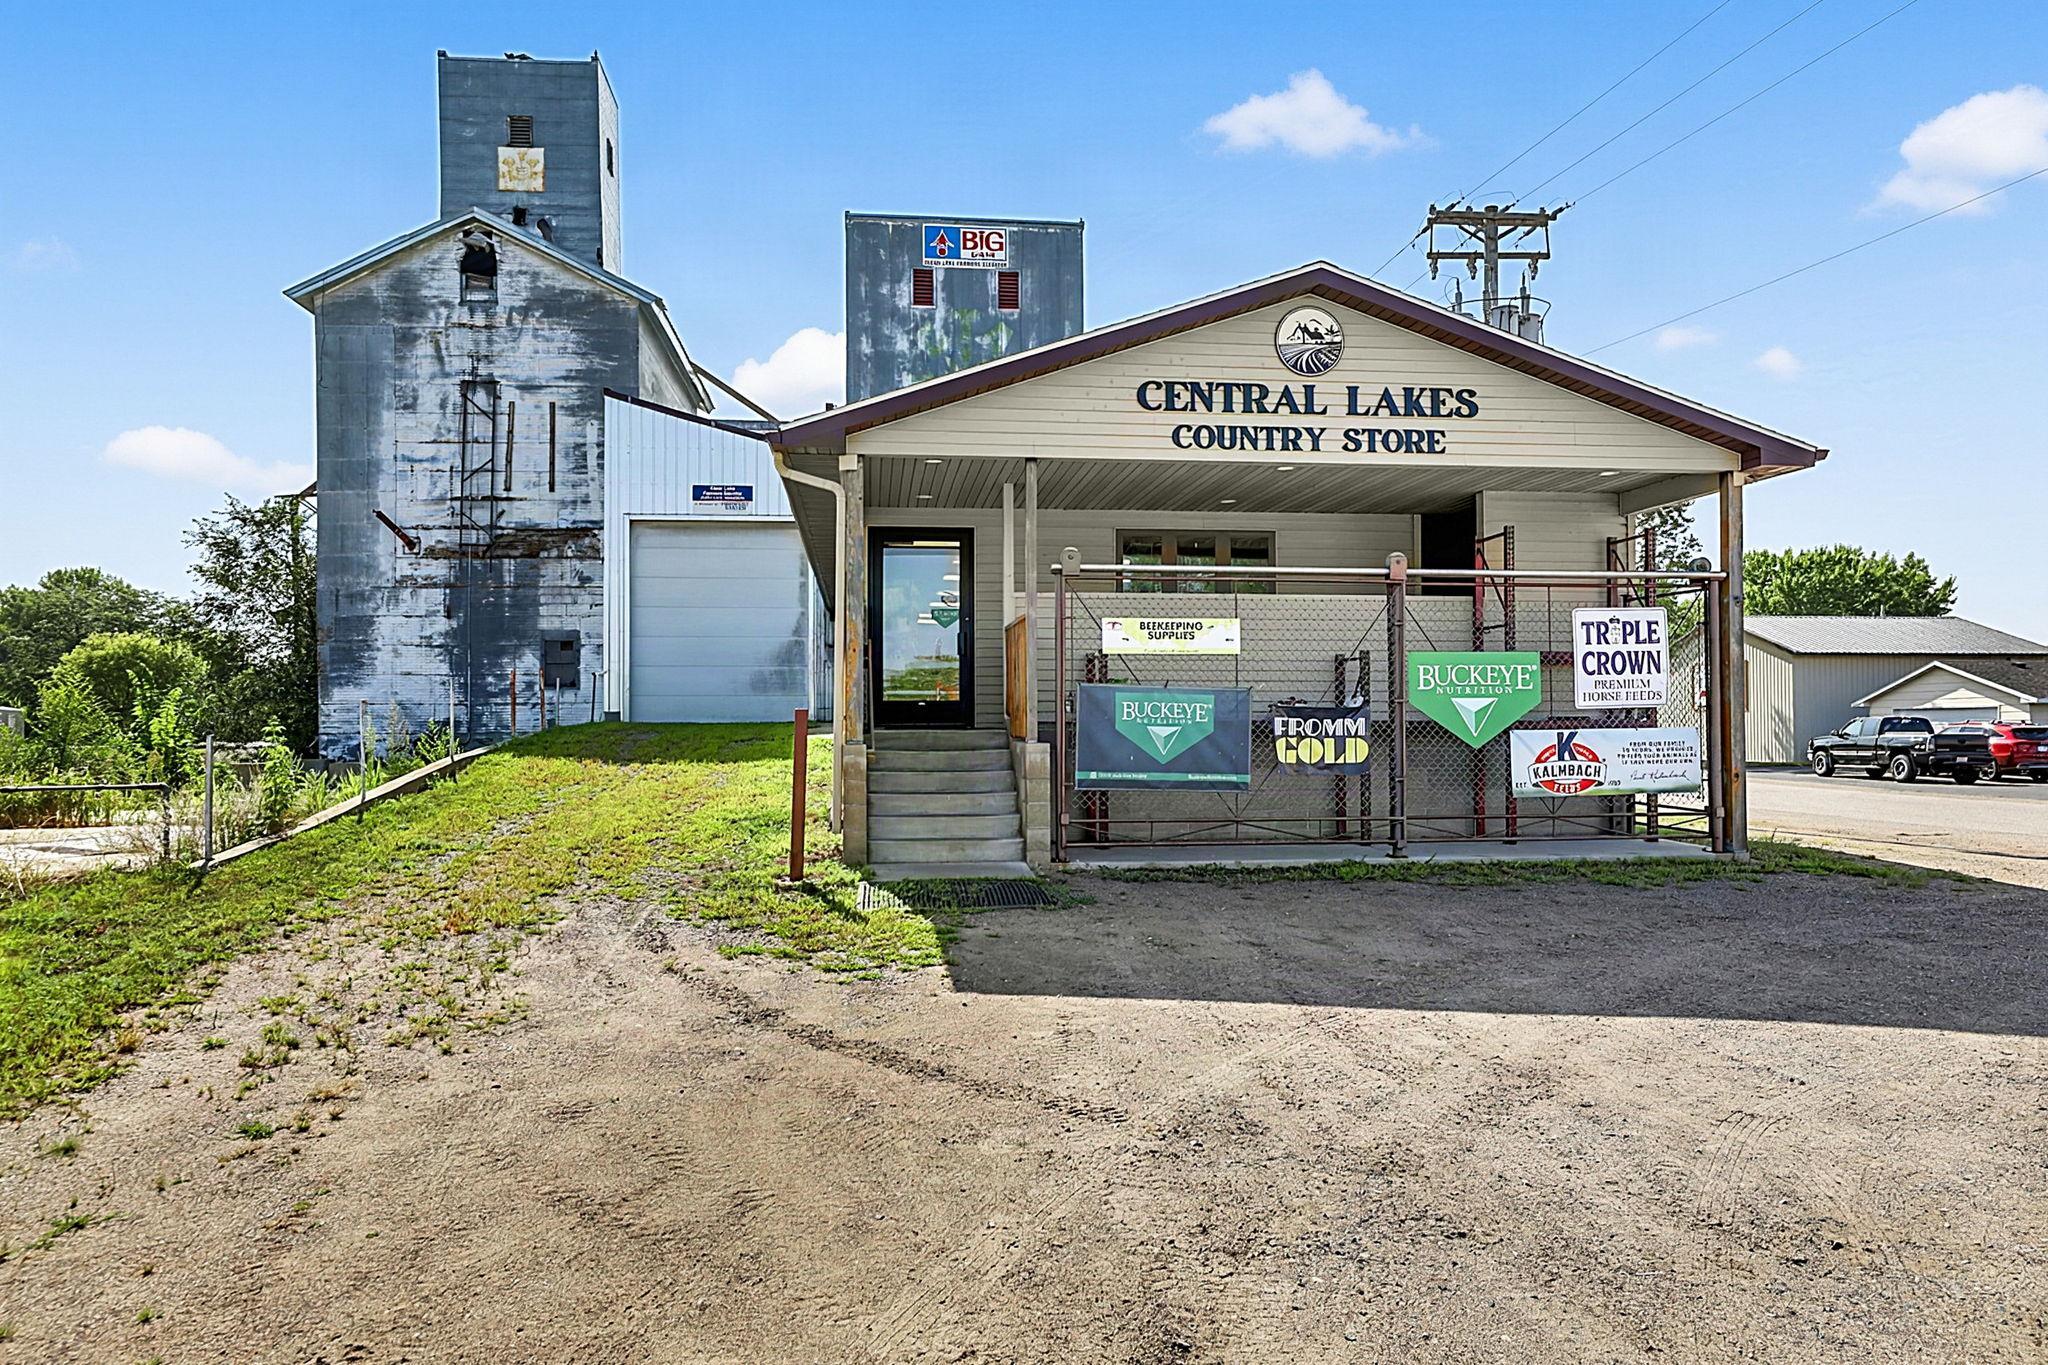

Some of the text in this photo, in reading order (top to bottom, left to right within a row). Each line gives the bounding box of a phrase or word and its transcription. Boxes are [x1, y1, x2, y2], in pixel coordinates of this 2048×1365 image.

[1136, 380, 1480, 418] CENTRAL LAKES
[1171, 424, 1447, 454] COUNTRY STORE
[1139, 621, 1203, 631] BEEKEEPING
[1147, 630, 1195, 640] SUPPLIES
[1580, 619, 1661, 645] TRIPLE
[1581, 650, 1662, 676] CROWN
[1417, 664, 1534, 690] BUCKEYE
[1594, 678, 1651, 690] PREMIUM
[1436, 686, 1513, 694] NUTRITION
[1583, 690, 1663, 702] HORSE FEEDS
[1121, 701, 1209, 722] BUCKEYE
[1274, 717, 1366, 737] FROMM
[1275, 736, 1369, 765] GOLD
[1557, 731, 1578, 761] K
[1533, 765, 1601, 780] KALMBACH
